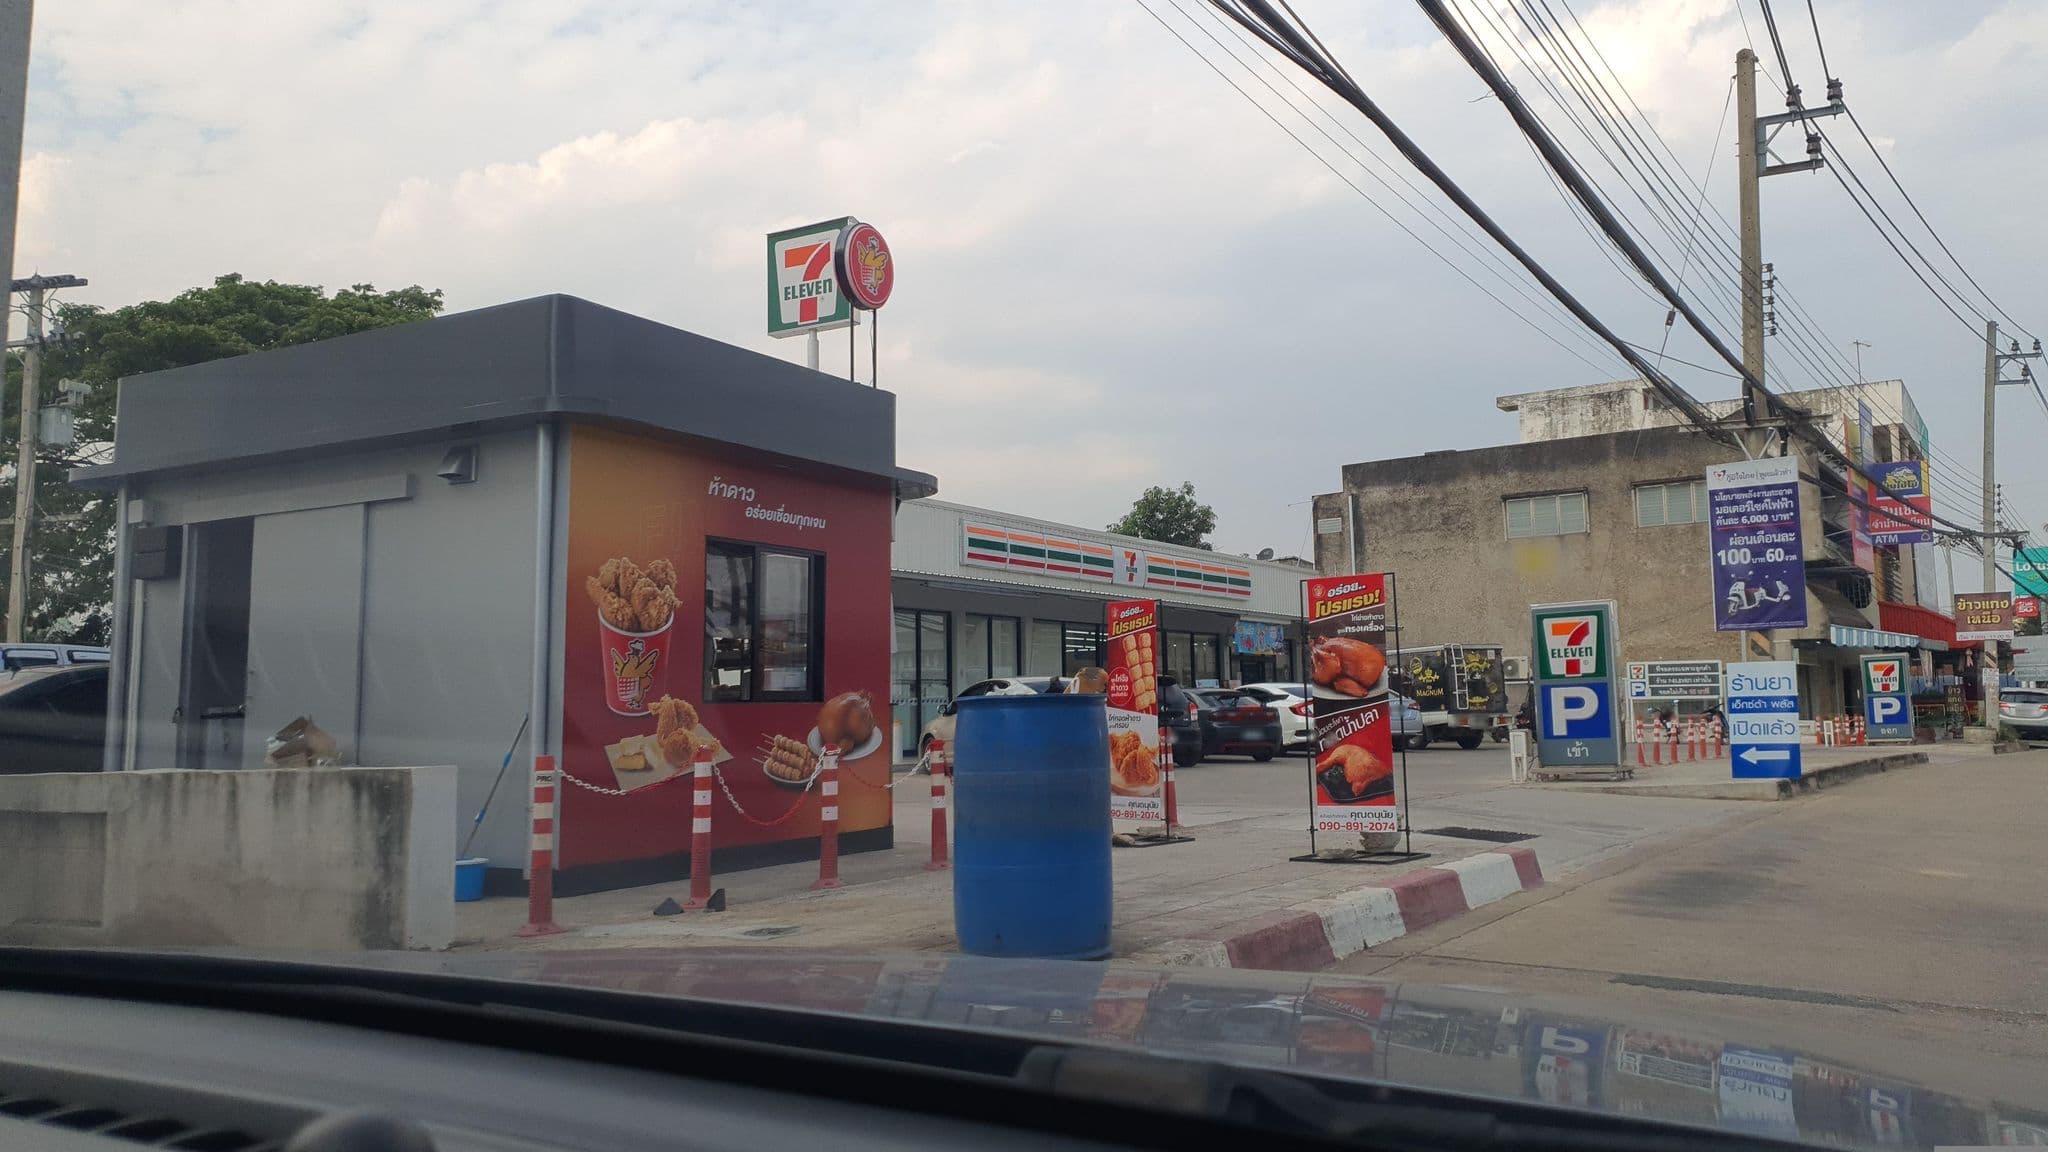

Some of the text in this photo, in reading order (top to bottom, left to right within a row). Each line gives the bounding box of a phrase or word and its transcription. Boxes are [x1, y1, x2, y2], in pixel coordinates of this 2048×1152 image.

[784, 241, 831, 323] 7
[708, 476, 755, 501] ห้าดาว
[745, 504, 826, 530] อร่อยเชื่อมทุกเจน
[1741, 515, 1768, 524] 6,000
[1729, 530, 1796, 546] ผ่อนเดือนละ
[1875, 535, 1898, 543] ATM
[1717, 548, 1751, 565] 100
[1766, 548, 1785, 562] 60
[1315, 589, 1381, 618] โปรแรง!
[1957, 598, 2009, 611] ข้าวแกง
[1112, 613, 1153, 636] โปรแรง!
[1551, 621, 1590, 675] 7
[1731, 673, 1791, 691] ร้านยา
[1872, 664, 1895, 691] 7
[1550, 686, 1599, 736] P
[1770, 699, 1794, 708] พลัส
[1873, 697, 1900, 723] P
[1733, 718, 1796, 736] เปิดแล้ว
[1567, 741, 1589, 757] เข้า
[1110, 809, 1159, 820] 90-891-2074
[1319, 821, 1395, 831] 090-891-2074
